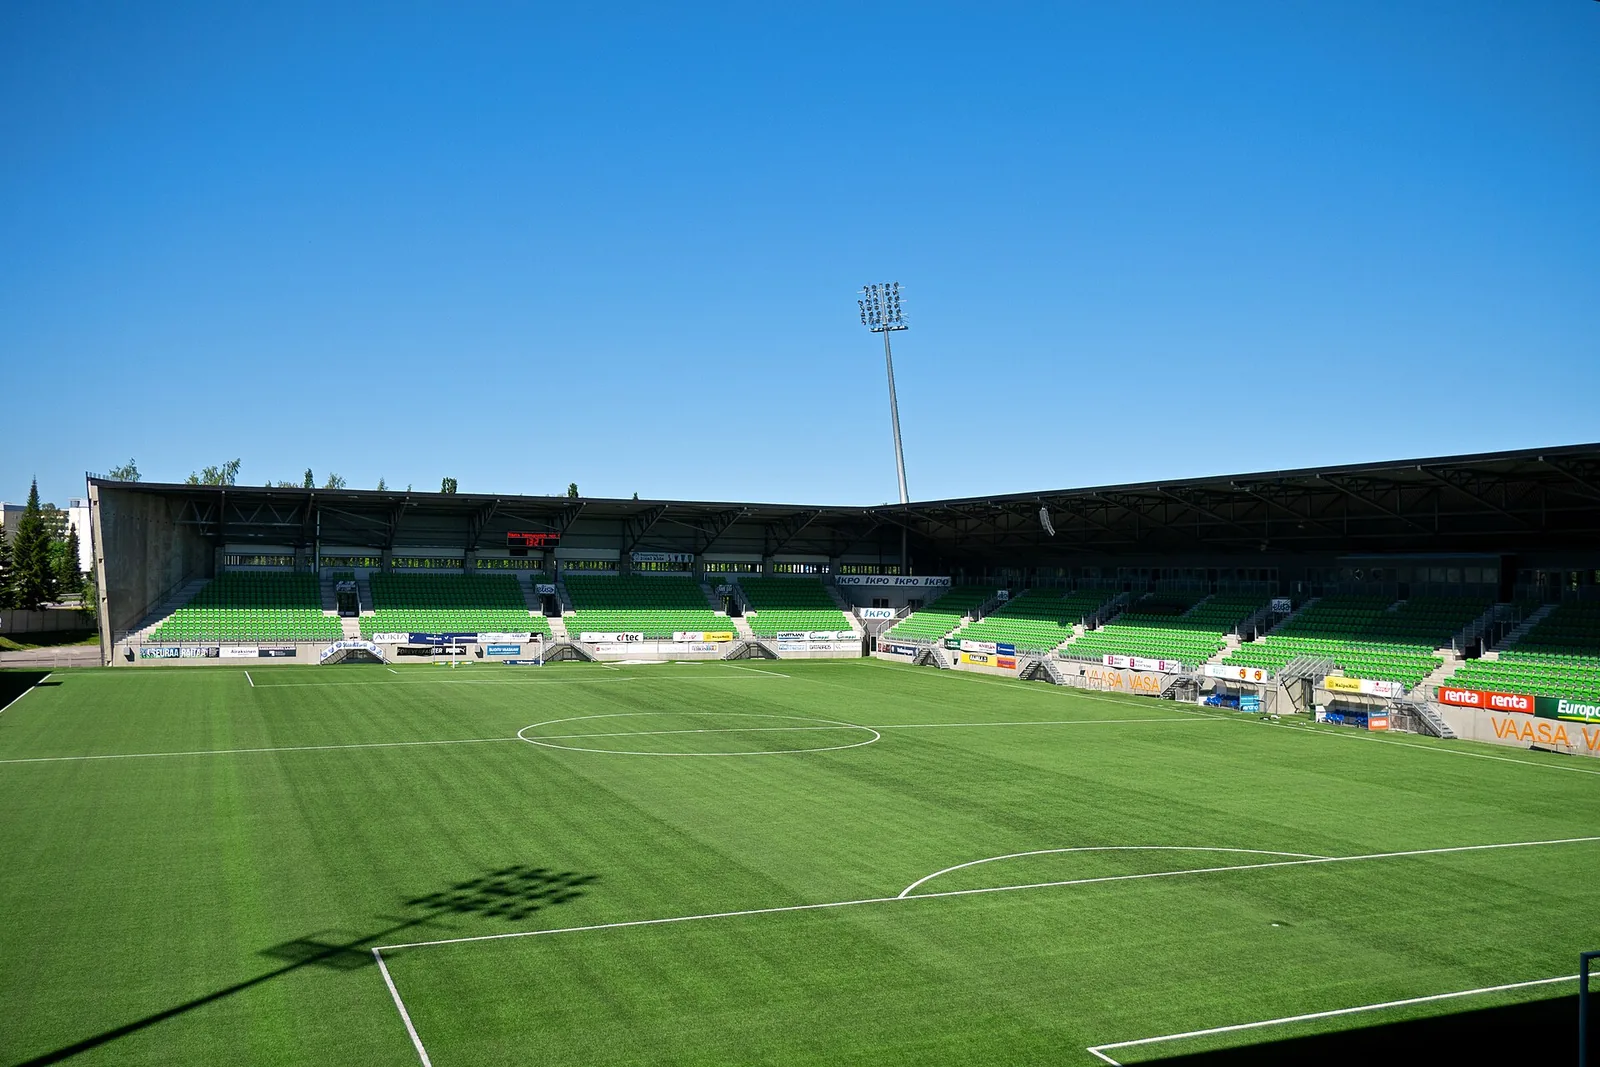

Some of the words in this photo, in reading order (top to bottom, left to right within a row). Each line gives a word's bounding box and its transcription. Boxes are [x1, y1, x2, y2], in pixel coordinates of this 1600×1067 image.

[1128, 674, 1160, 692] VASA
[1444, 690, 1478, 704] renta
[1491, 694, 1528, 709] renta
[1491, 716, 1570, 748] VAASA
